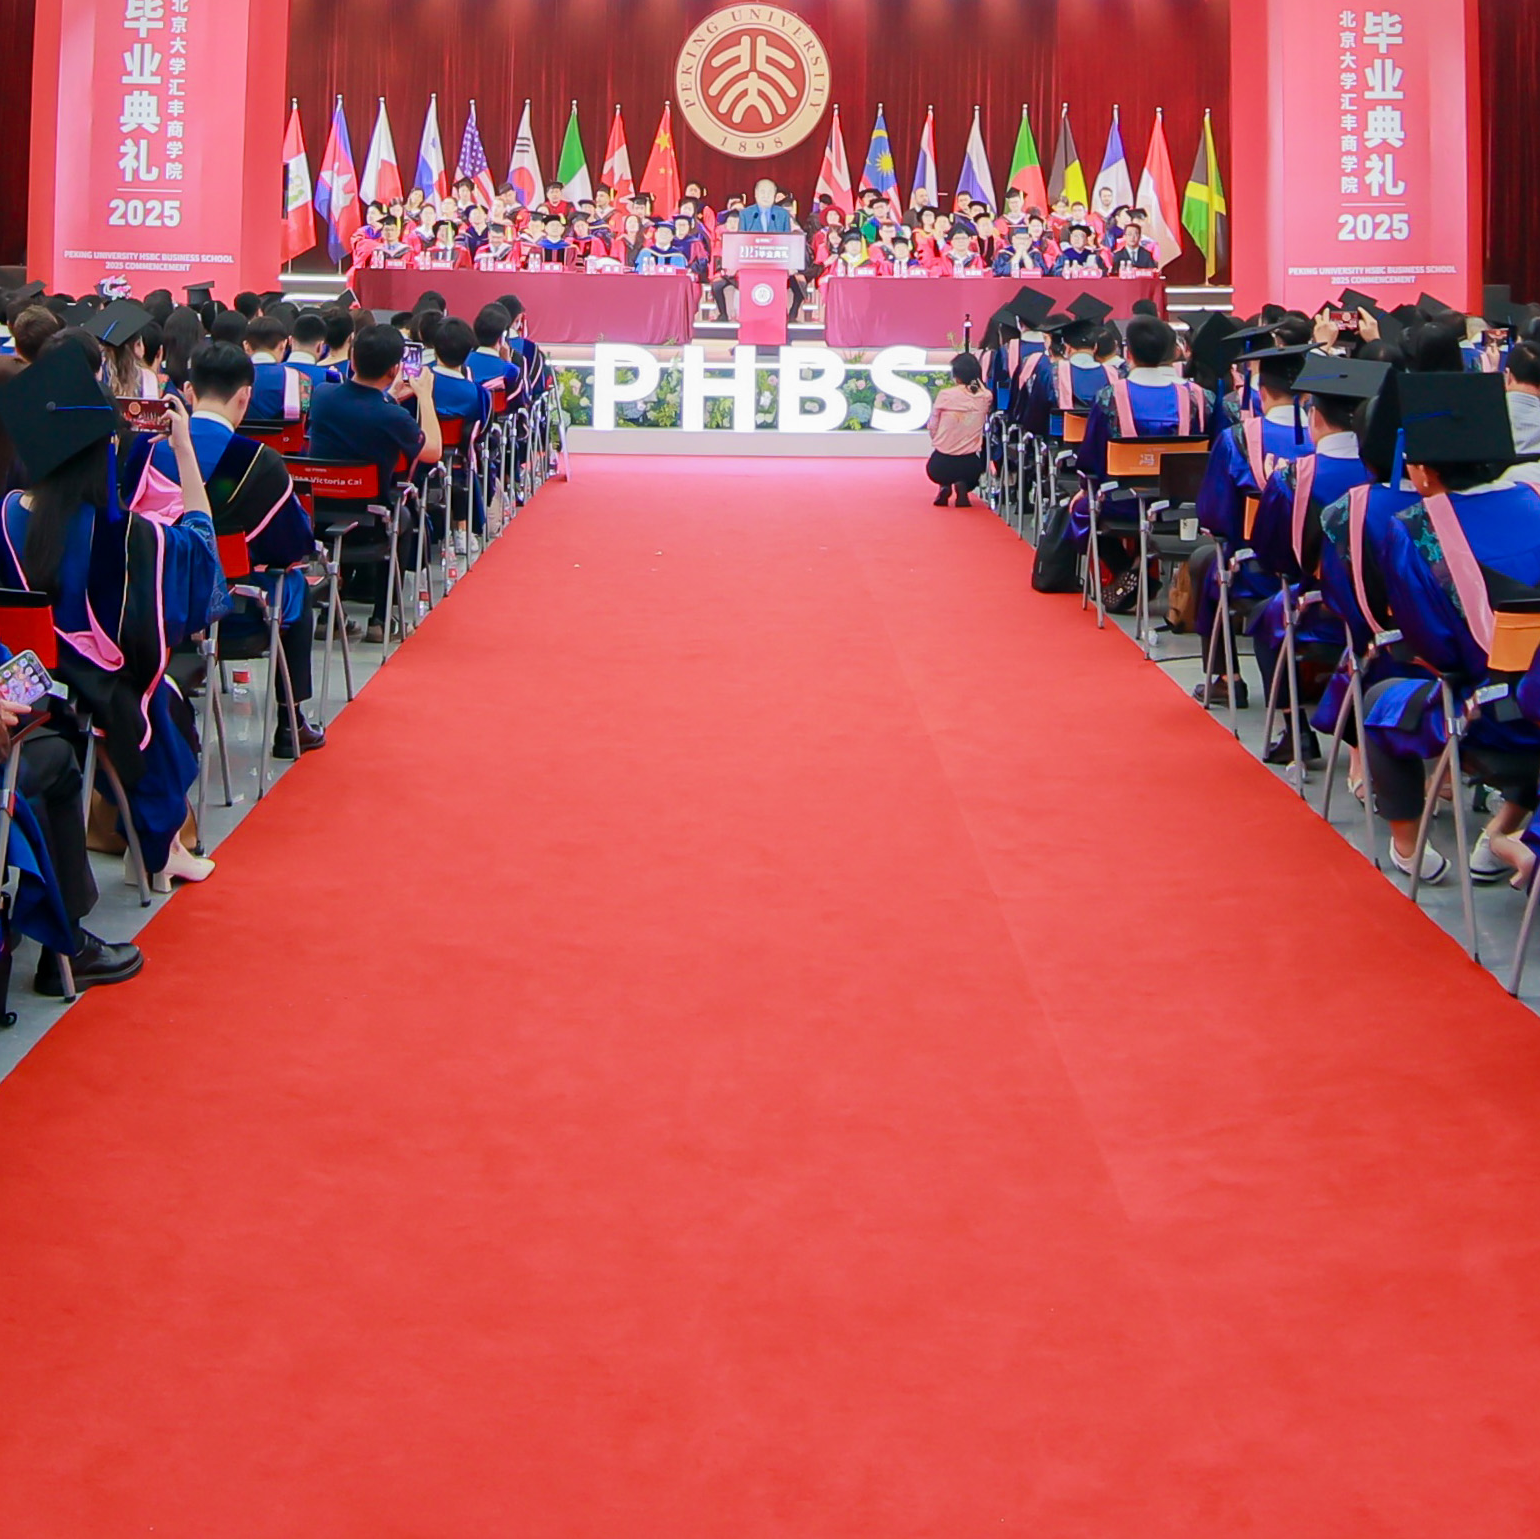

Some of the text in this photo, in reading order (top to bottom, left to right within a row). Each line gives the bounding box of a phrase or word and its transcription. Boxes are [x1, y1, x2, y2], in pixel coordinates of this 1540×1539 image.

[681, 8, 825, 113] PEKING UNIVERSITY
[1338, 10, 1359, 194] 北京大学汇丰商学院
[1362, 10, 1406, 197] 毕业典礼
[720, 135, 784, 153] 1898
[107, 198, 181, 227] 2025
[1337, 212, 1410, 241] 2025
[63, 250, 235, 263] PEKING UNIVERSITY HSBC BUSINESS SCHOOL
[124, 262, 191, 272] COMMENCEMENT
[1318, 266, 1364, 275] UNIVERSITY
[1425, 265, 1457, 274] SCHOOL
[593, 343, 933, 434] PHBS
[310, 476, 346, 486] Victoria
[347, 478, 363, 486] Cai
